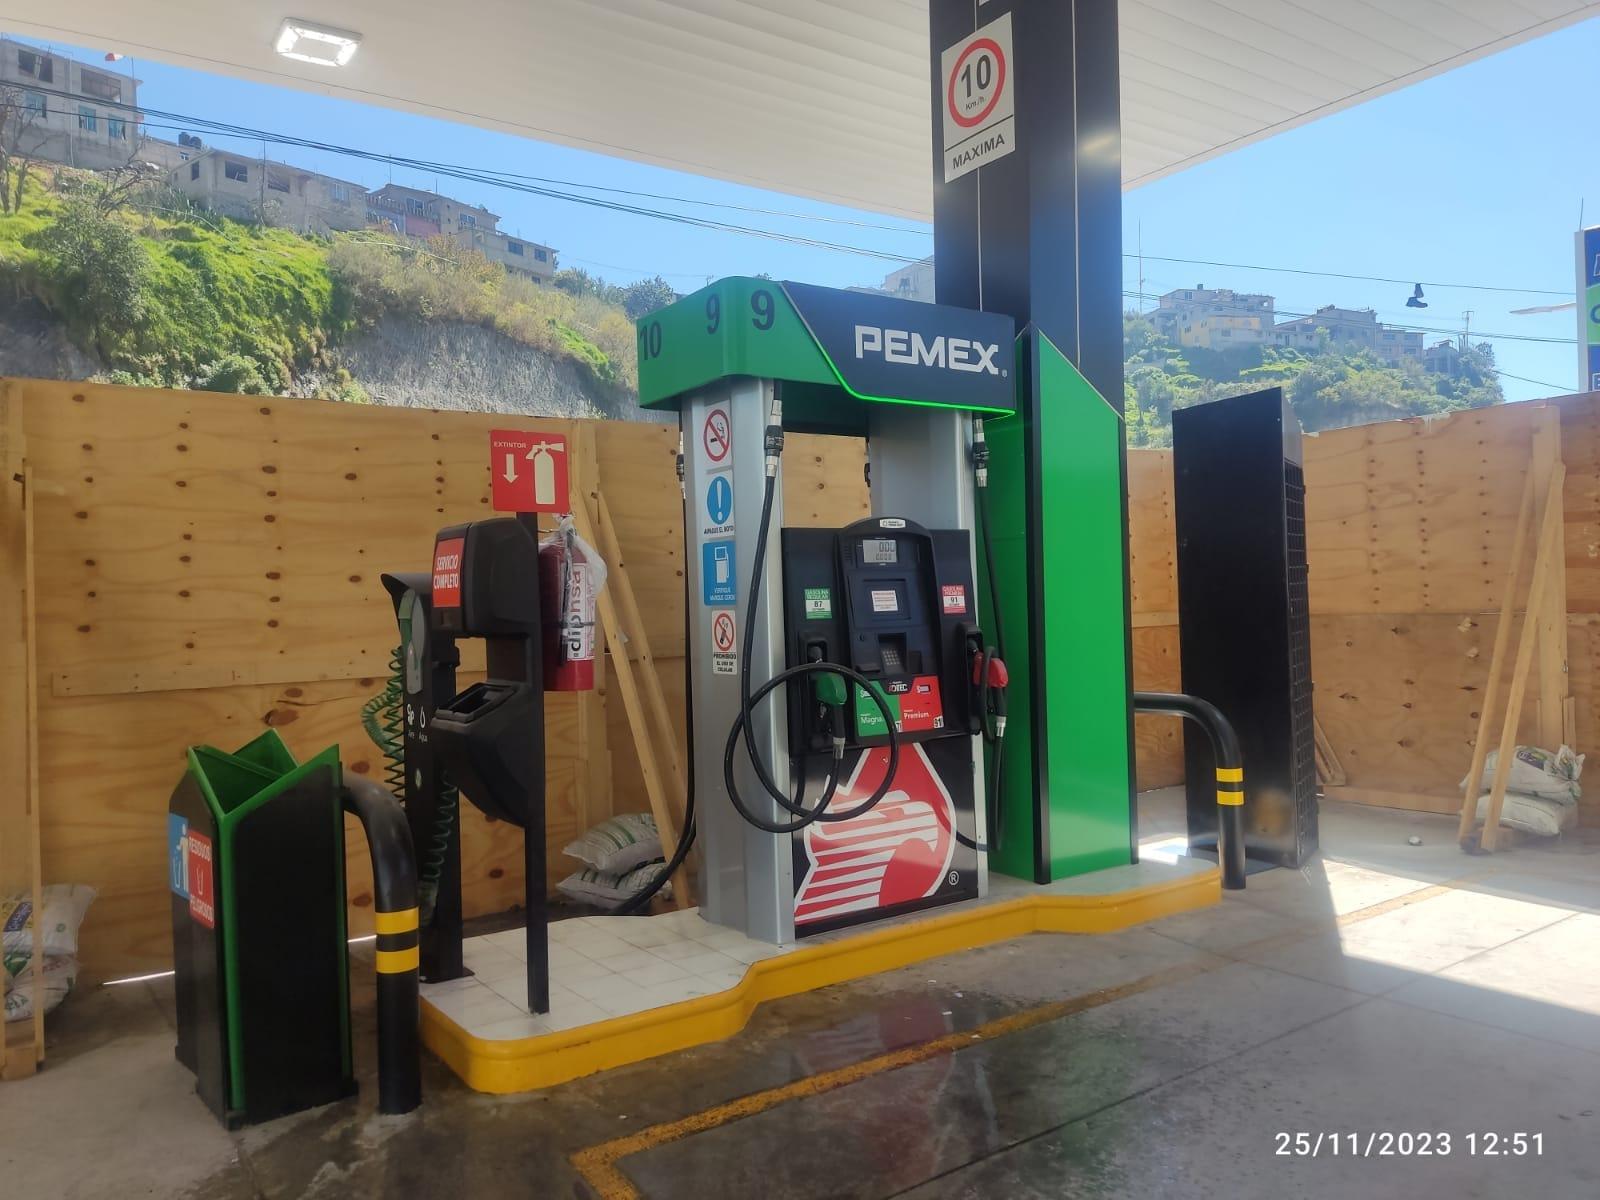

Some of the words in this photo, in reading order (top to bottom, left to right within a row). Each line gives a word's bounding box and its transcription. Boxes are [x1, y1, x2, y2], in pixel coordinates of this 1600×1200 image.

[961, 54, 991, 98] 10
[952, 133, 1005, 169] MAXIMA
[705, 293, 720, 335] 9
[751, 289, 776, 331] 9
[639, 320, 662, 360] 10
[854, 324, 999, 376] PEMEX
[493, 441, 527, 449] EXTINTOR
[436, 554, 458, 571] SERVICIO
[433, 573, 459, 589] COMPLETO
[814, 600, 823, 608] 87
[860, 716, 882, 726] Magna
[903, 712, 929, 720] Premium
